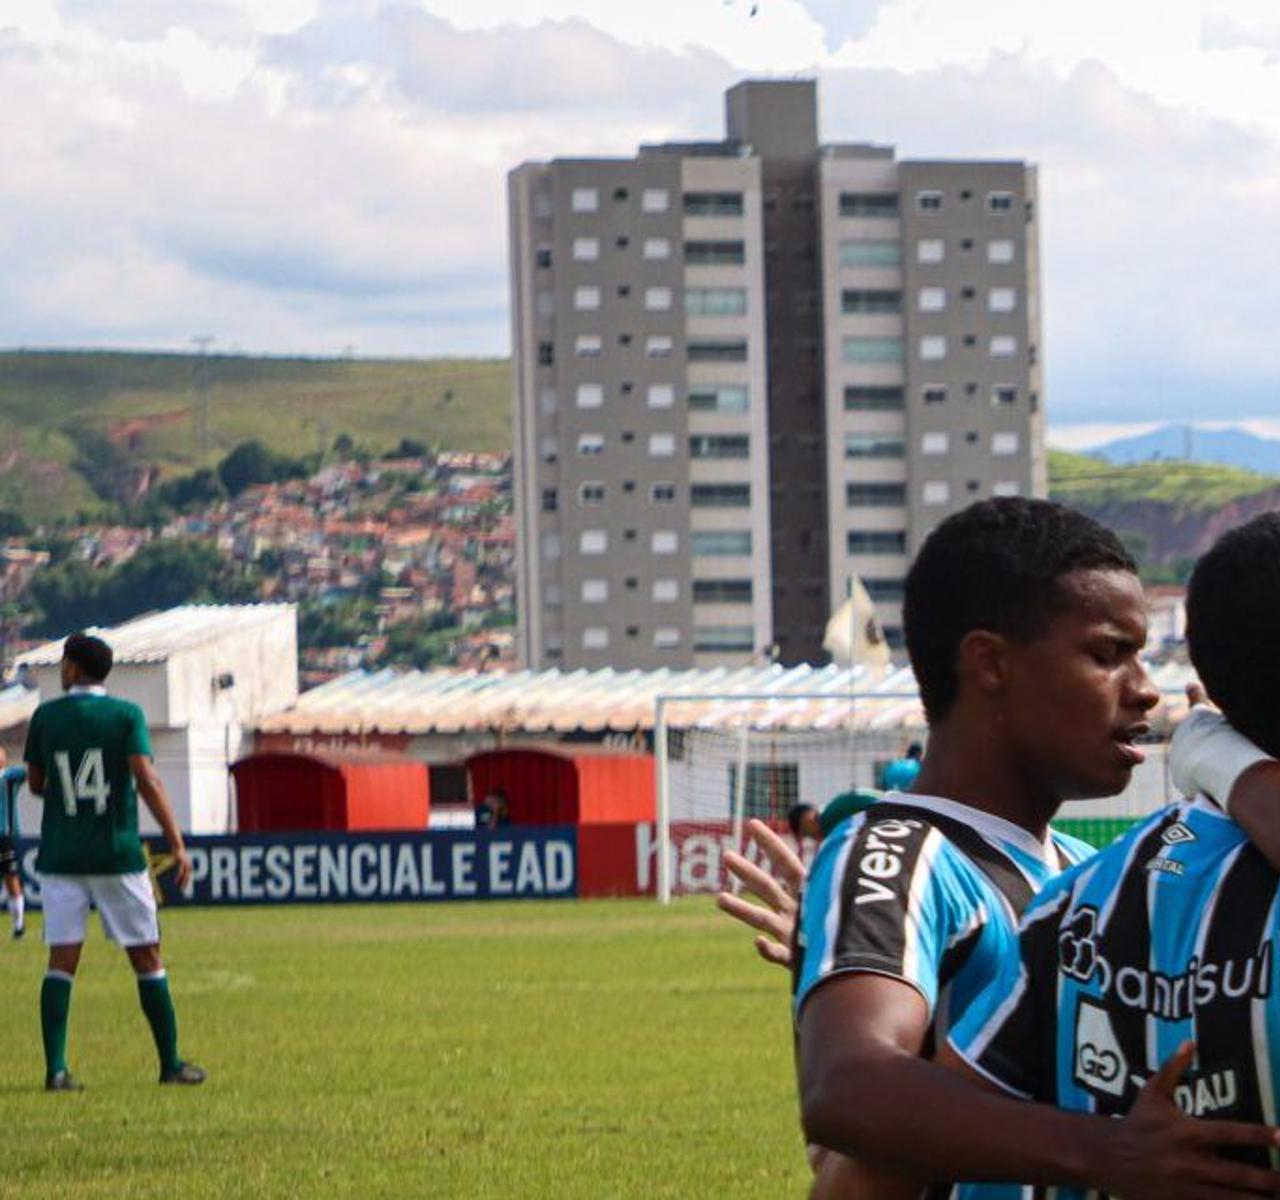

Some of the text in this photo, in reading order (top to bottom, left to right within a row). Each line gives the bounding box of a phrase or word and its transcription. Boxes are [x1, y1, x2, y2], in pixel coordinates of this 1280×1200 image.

[54, 749, 110, 816] 14
[182, 840, 574, 898] PRESENCIAL E EAD
